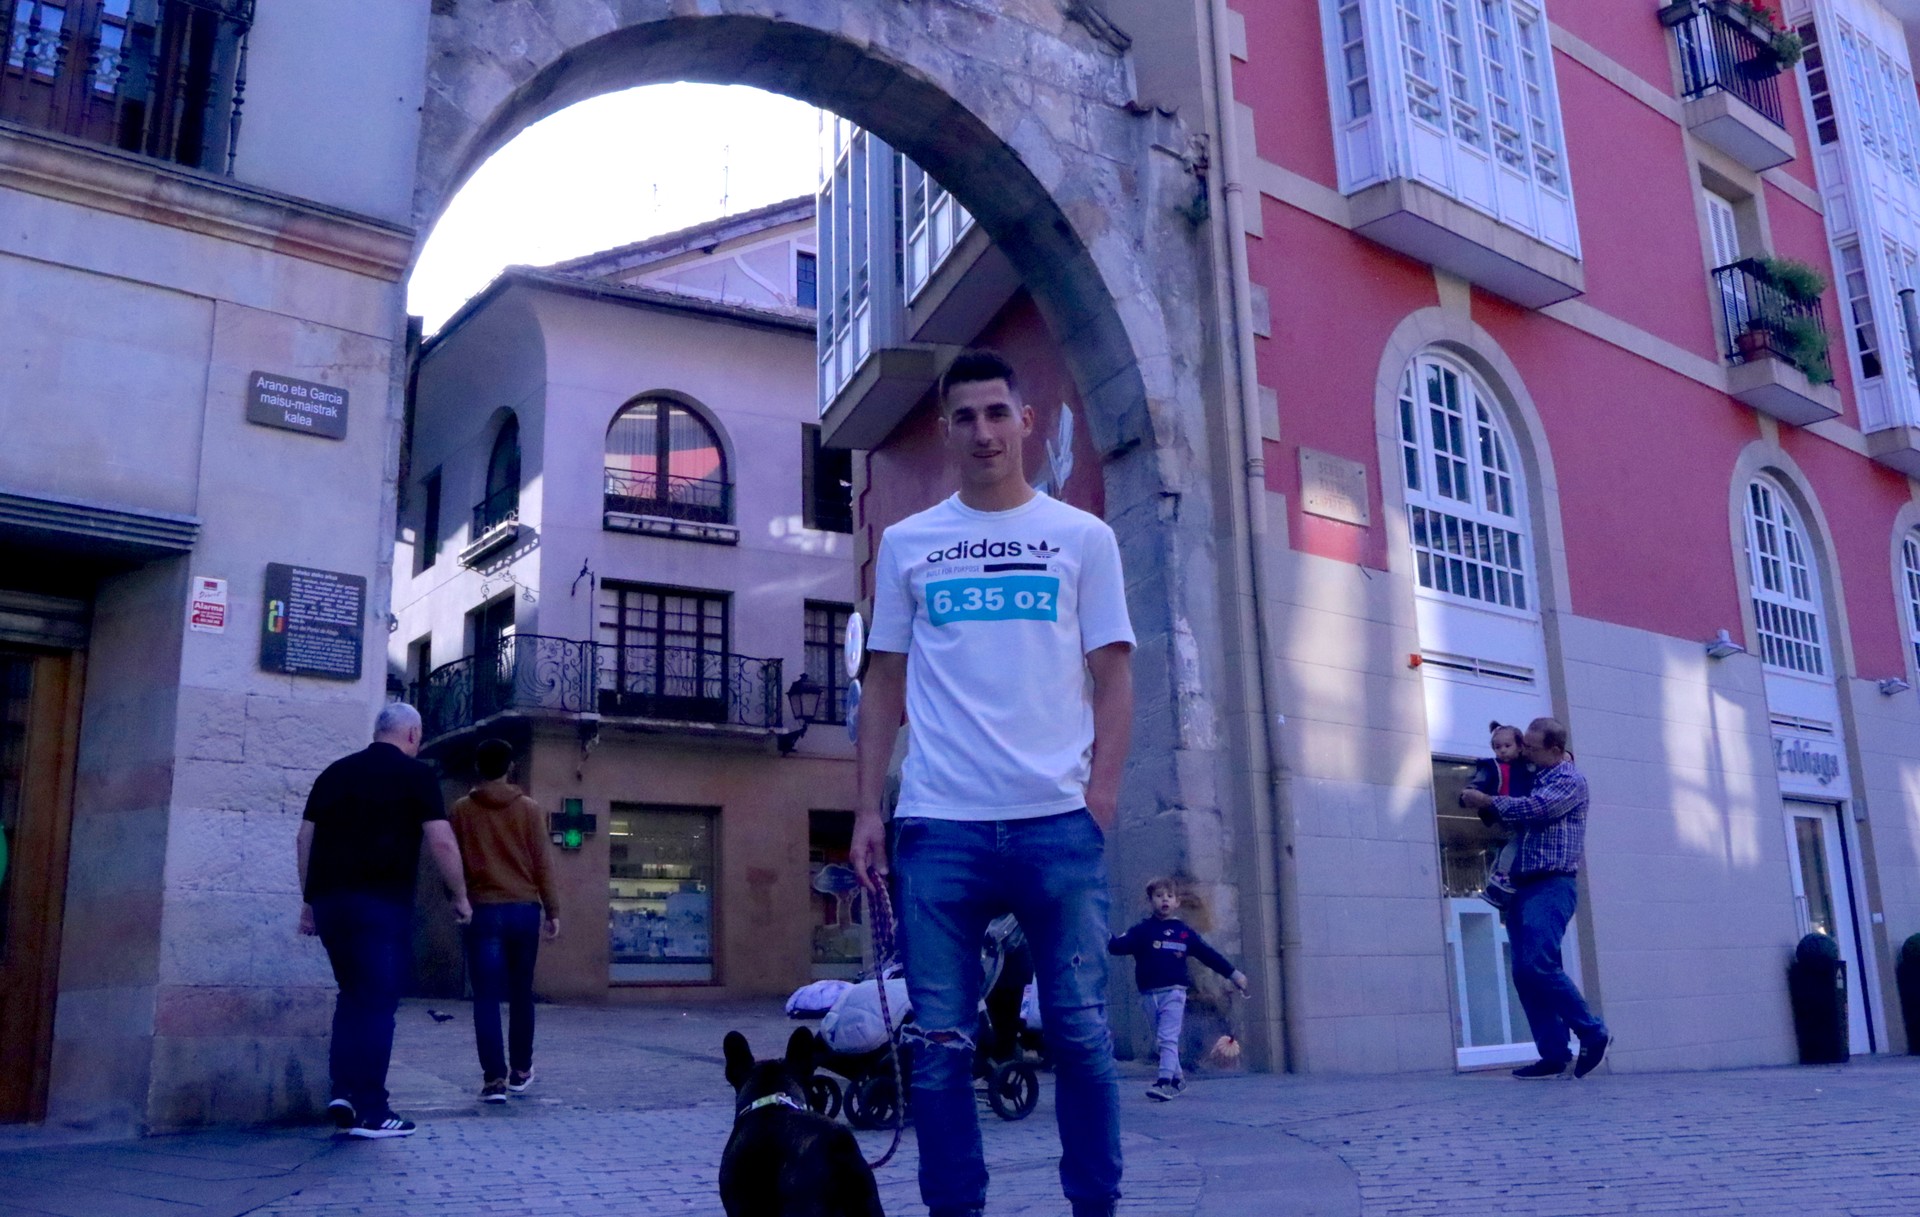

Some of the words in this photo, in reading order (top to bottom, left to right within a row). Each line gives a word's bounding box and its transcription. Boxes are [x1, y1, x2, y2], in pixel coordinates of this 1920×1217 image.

[257, 376, 288, 393] Arano
[291, 385, 307, 397] eta
[310, 388, 343, 405] Garcia
[260, 393, 338, 418] maisu-maistrak
[284, 410, 312, 426] kalea
[926, 538, 1022, 563] adidas
[926, 568, 941, 578] BUILT
[942, 567, 953, 575] FOR
[953, 565, 980, 574] PURPOSE
[194, 602, 223, 612] Alarma
[933, 586, 1005, 615] 6.35
[1014, 590, 1052, 611] oz
